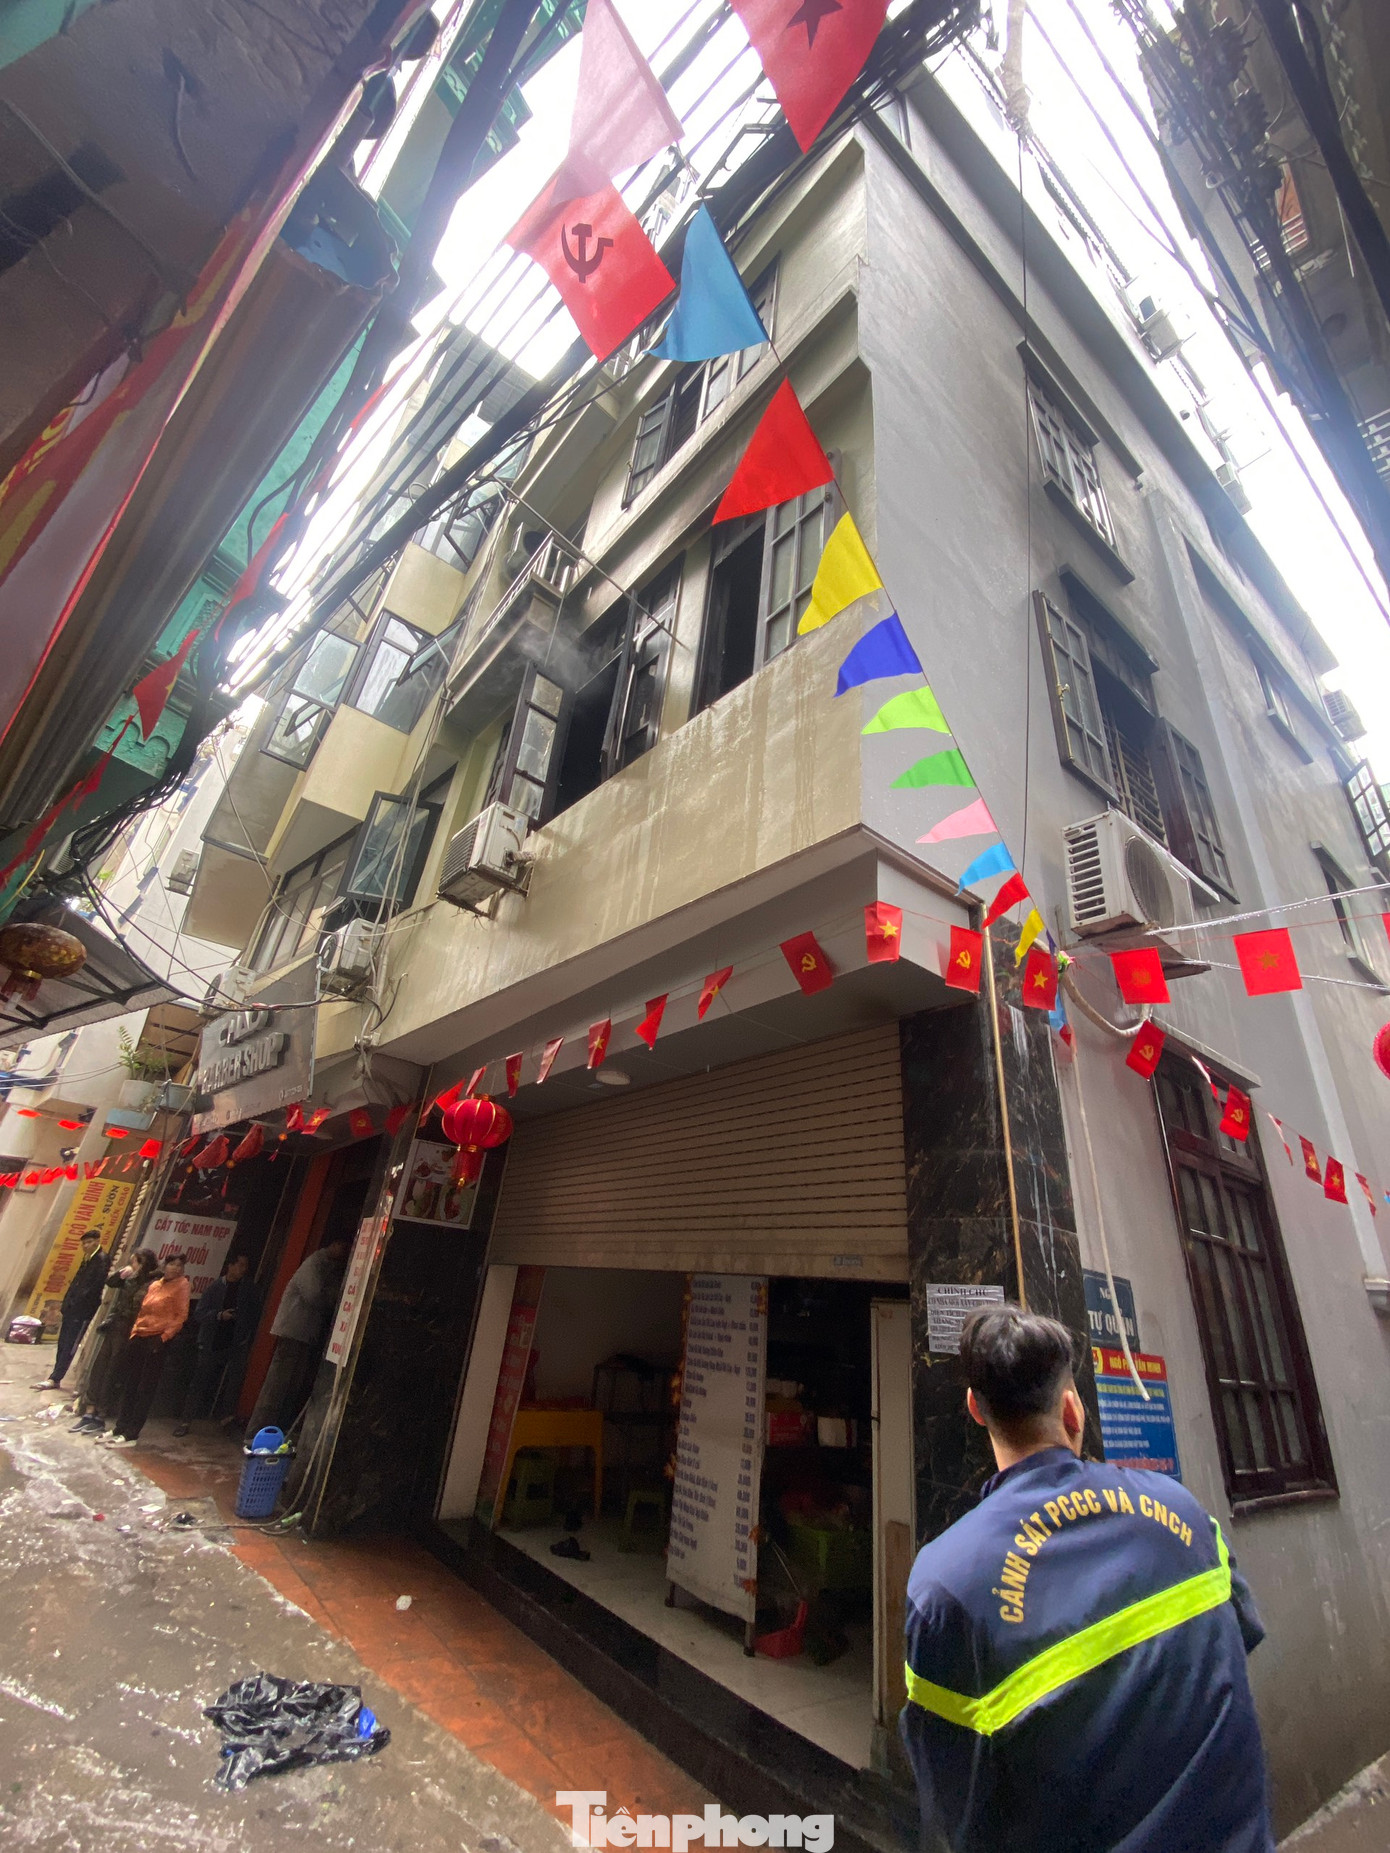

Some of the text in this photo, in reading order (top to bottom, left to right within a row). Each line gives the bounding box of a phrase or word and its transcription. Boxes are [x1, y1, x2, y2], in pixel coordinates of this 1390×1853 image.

[174, 1219, 190, 1234] TÓC
[191, 1223, 213, 1237] NAM
[1087, 1310, 1102, 1335] TỰ
[992, 1487, 1192, 1624] CẢNH SÁT PCCC VÀ CNCH
